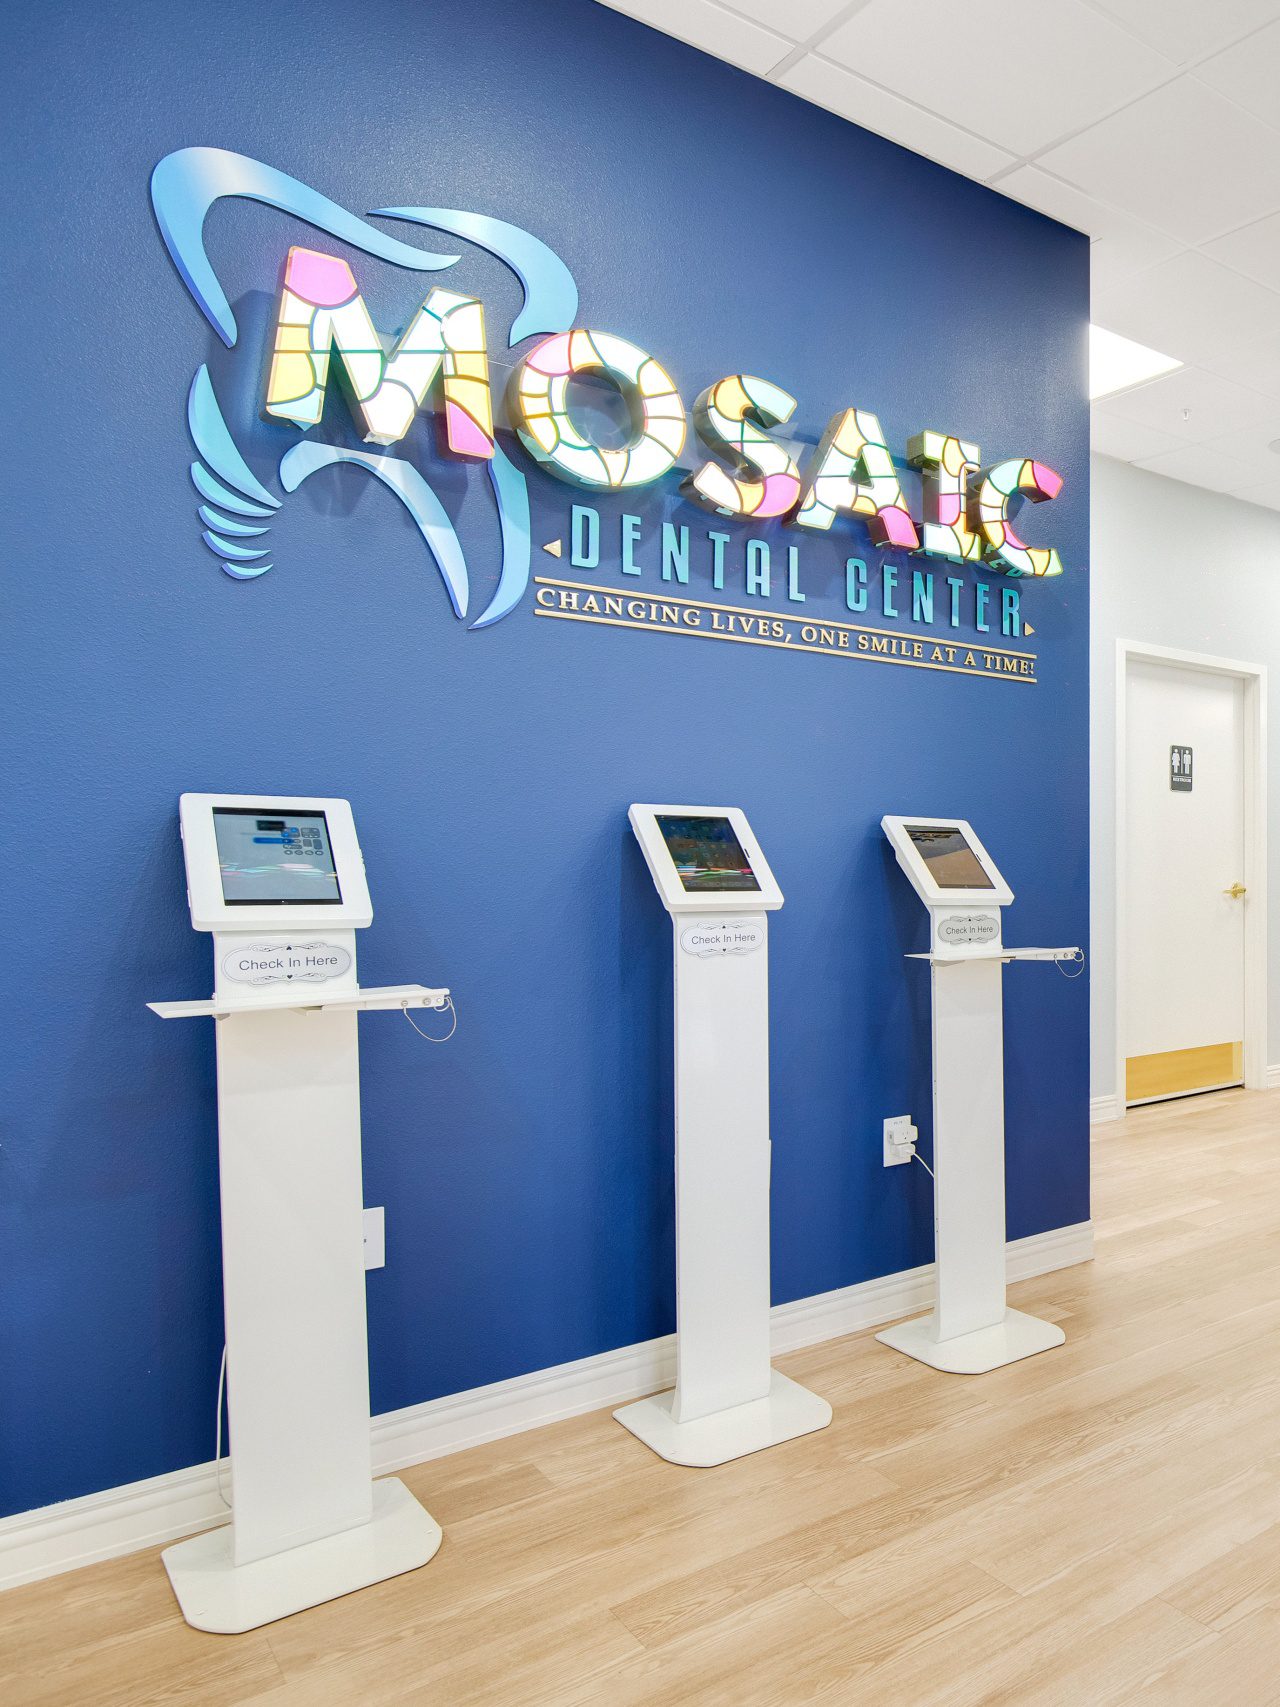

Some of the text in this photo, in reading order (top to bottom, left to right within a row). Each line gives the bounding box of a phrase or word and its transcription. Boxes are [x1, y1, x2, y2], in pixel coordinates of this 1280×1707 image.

[262, 245, 1064, 578] MOSAIC
[571, 504, 1020, 637] DENTAL CENTER
[536, 587, 1034, 675] CHANGING LIVES, ONE SMILE AT A TIME!
[691, 933, 756, 945] Check In Here
[945, 926, 968, 935] Check
[977, 925, 994, 933] Here
[239, 955, 338, 971] Check In Here
